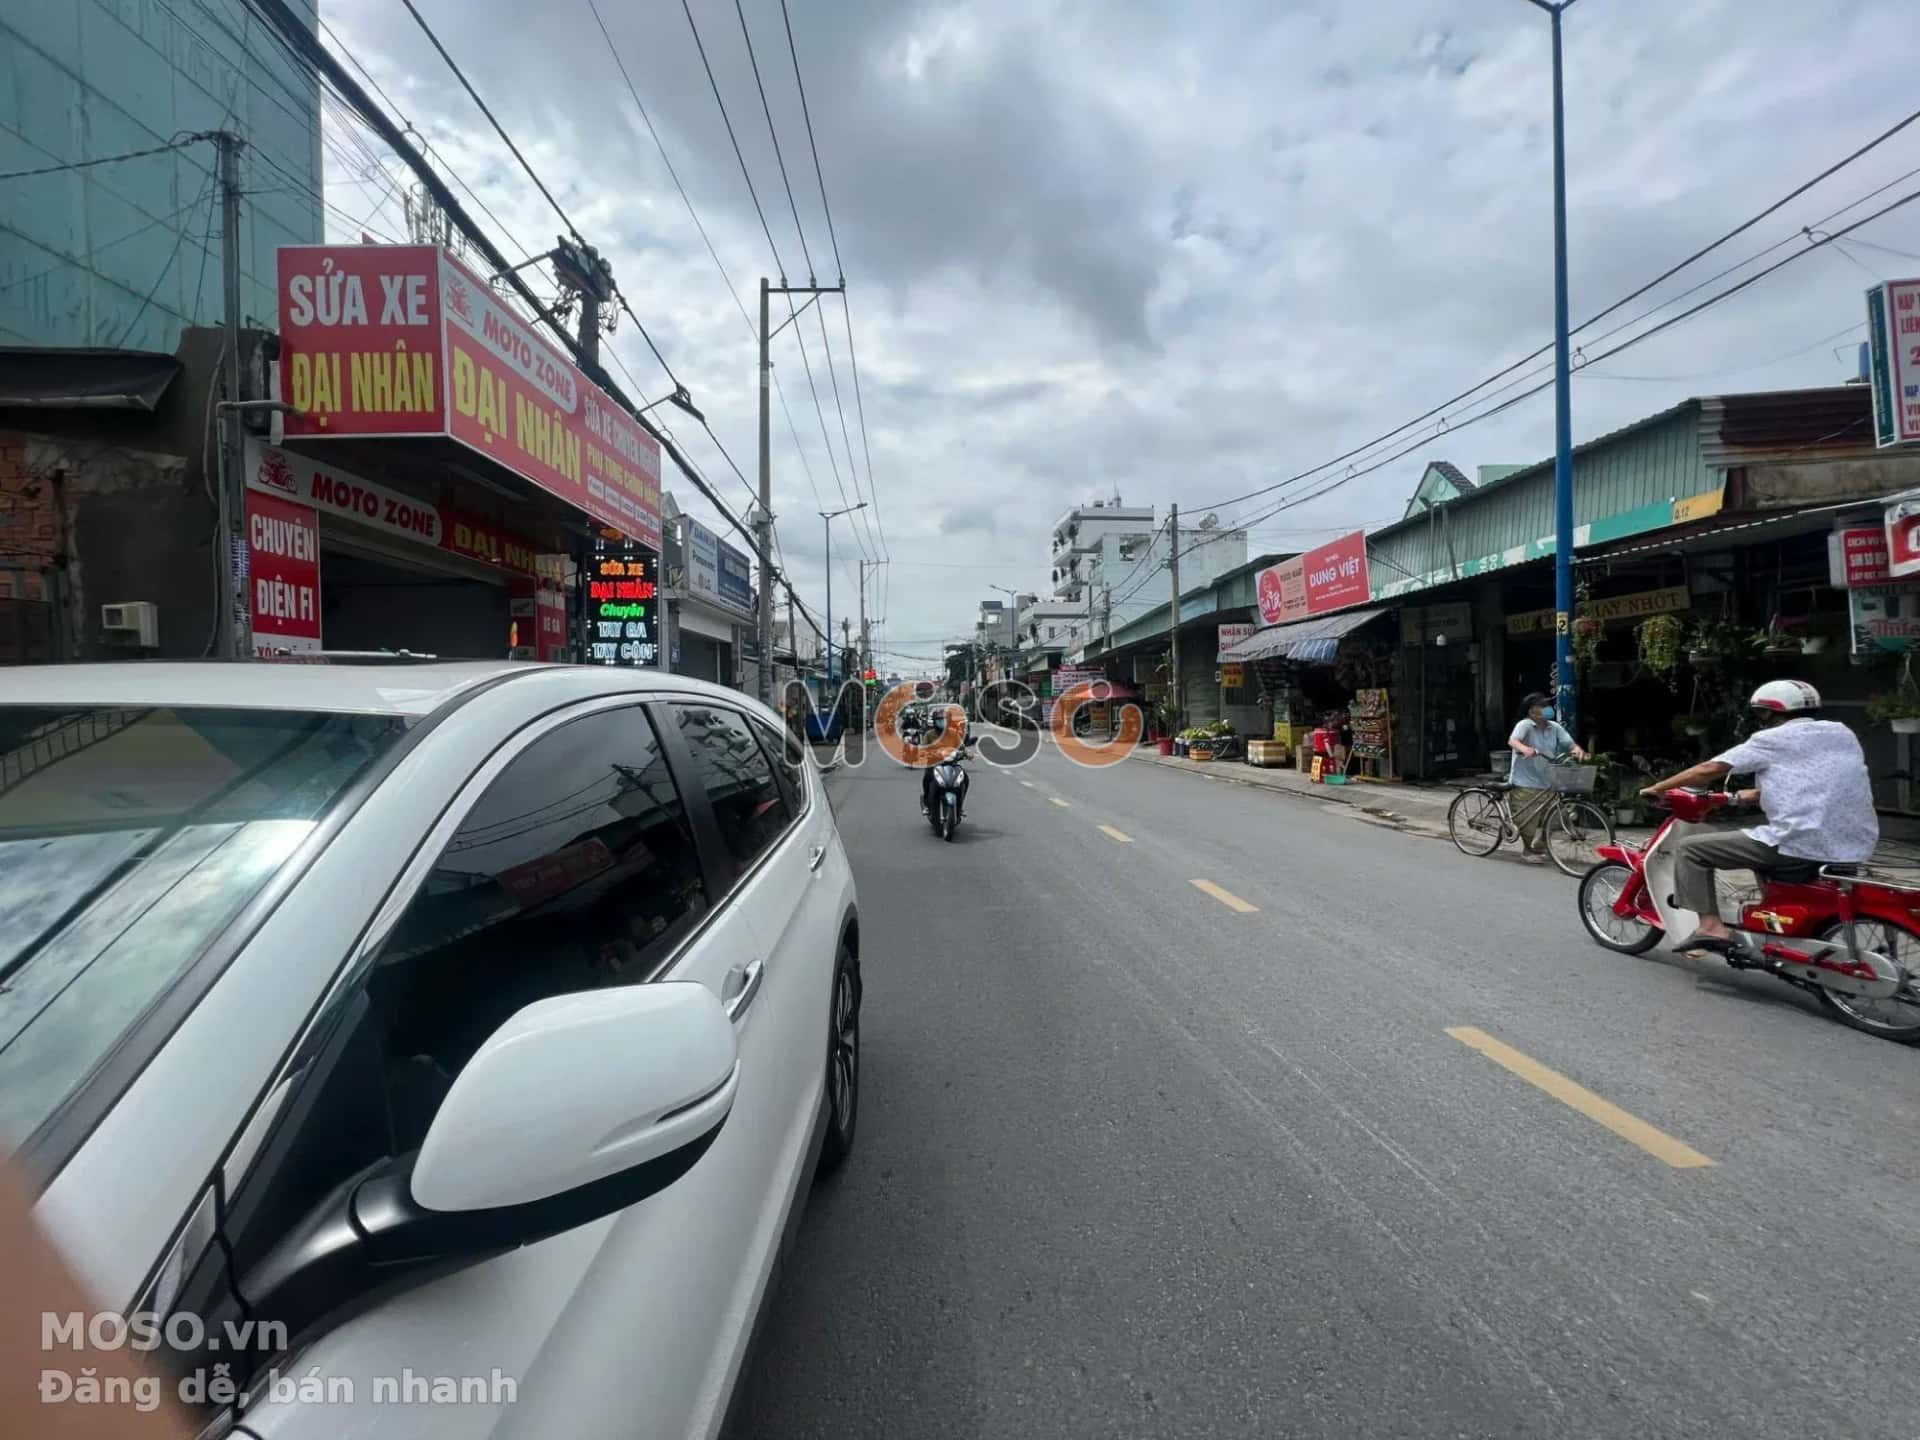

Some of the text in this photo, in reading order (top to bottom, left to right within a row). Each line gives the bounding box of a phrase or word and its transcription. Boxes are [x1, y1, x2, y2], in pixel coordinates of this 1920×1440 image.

[289, 257, 429, 327] SỬA XE
[291, 338, 435, 427] ĐẠI NHÂN
[483, 310, 573, 402] MOTO ZONE
[453, 345, 581, 485] ĐẠI NHÂN
[311, 472, 435, 537] MOTO ZONE
[251, 513, 315, 563] CHUYÊN
[627, 562, 644, 576] XE
[1309, 567, 1337, 588] DUNG
[1339, 555, 1360, 580] VIỆT
[257, 573, 297, 626] ĐIỆN
[301, 587, 314, 622] FI
[600, 602, 645, 619] Chuyên
[620, 640, 654, 660] CÔN
